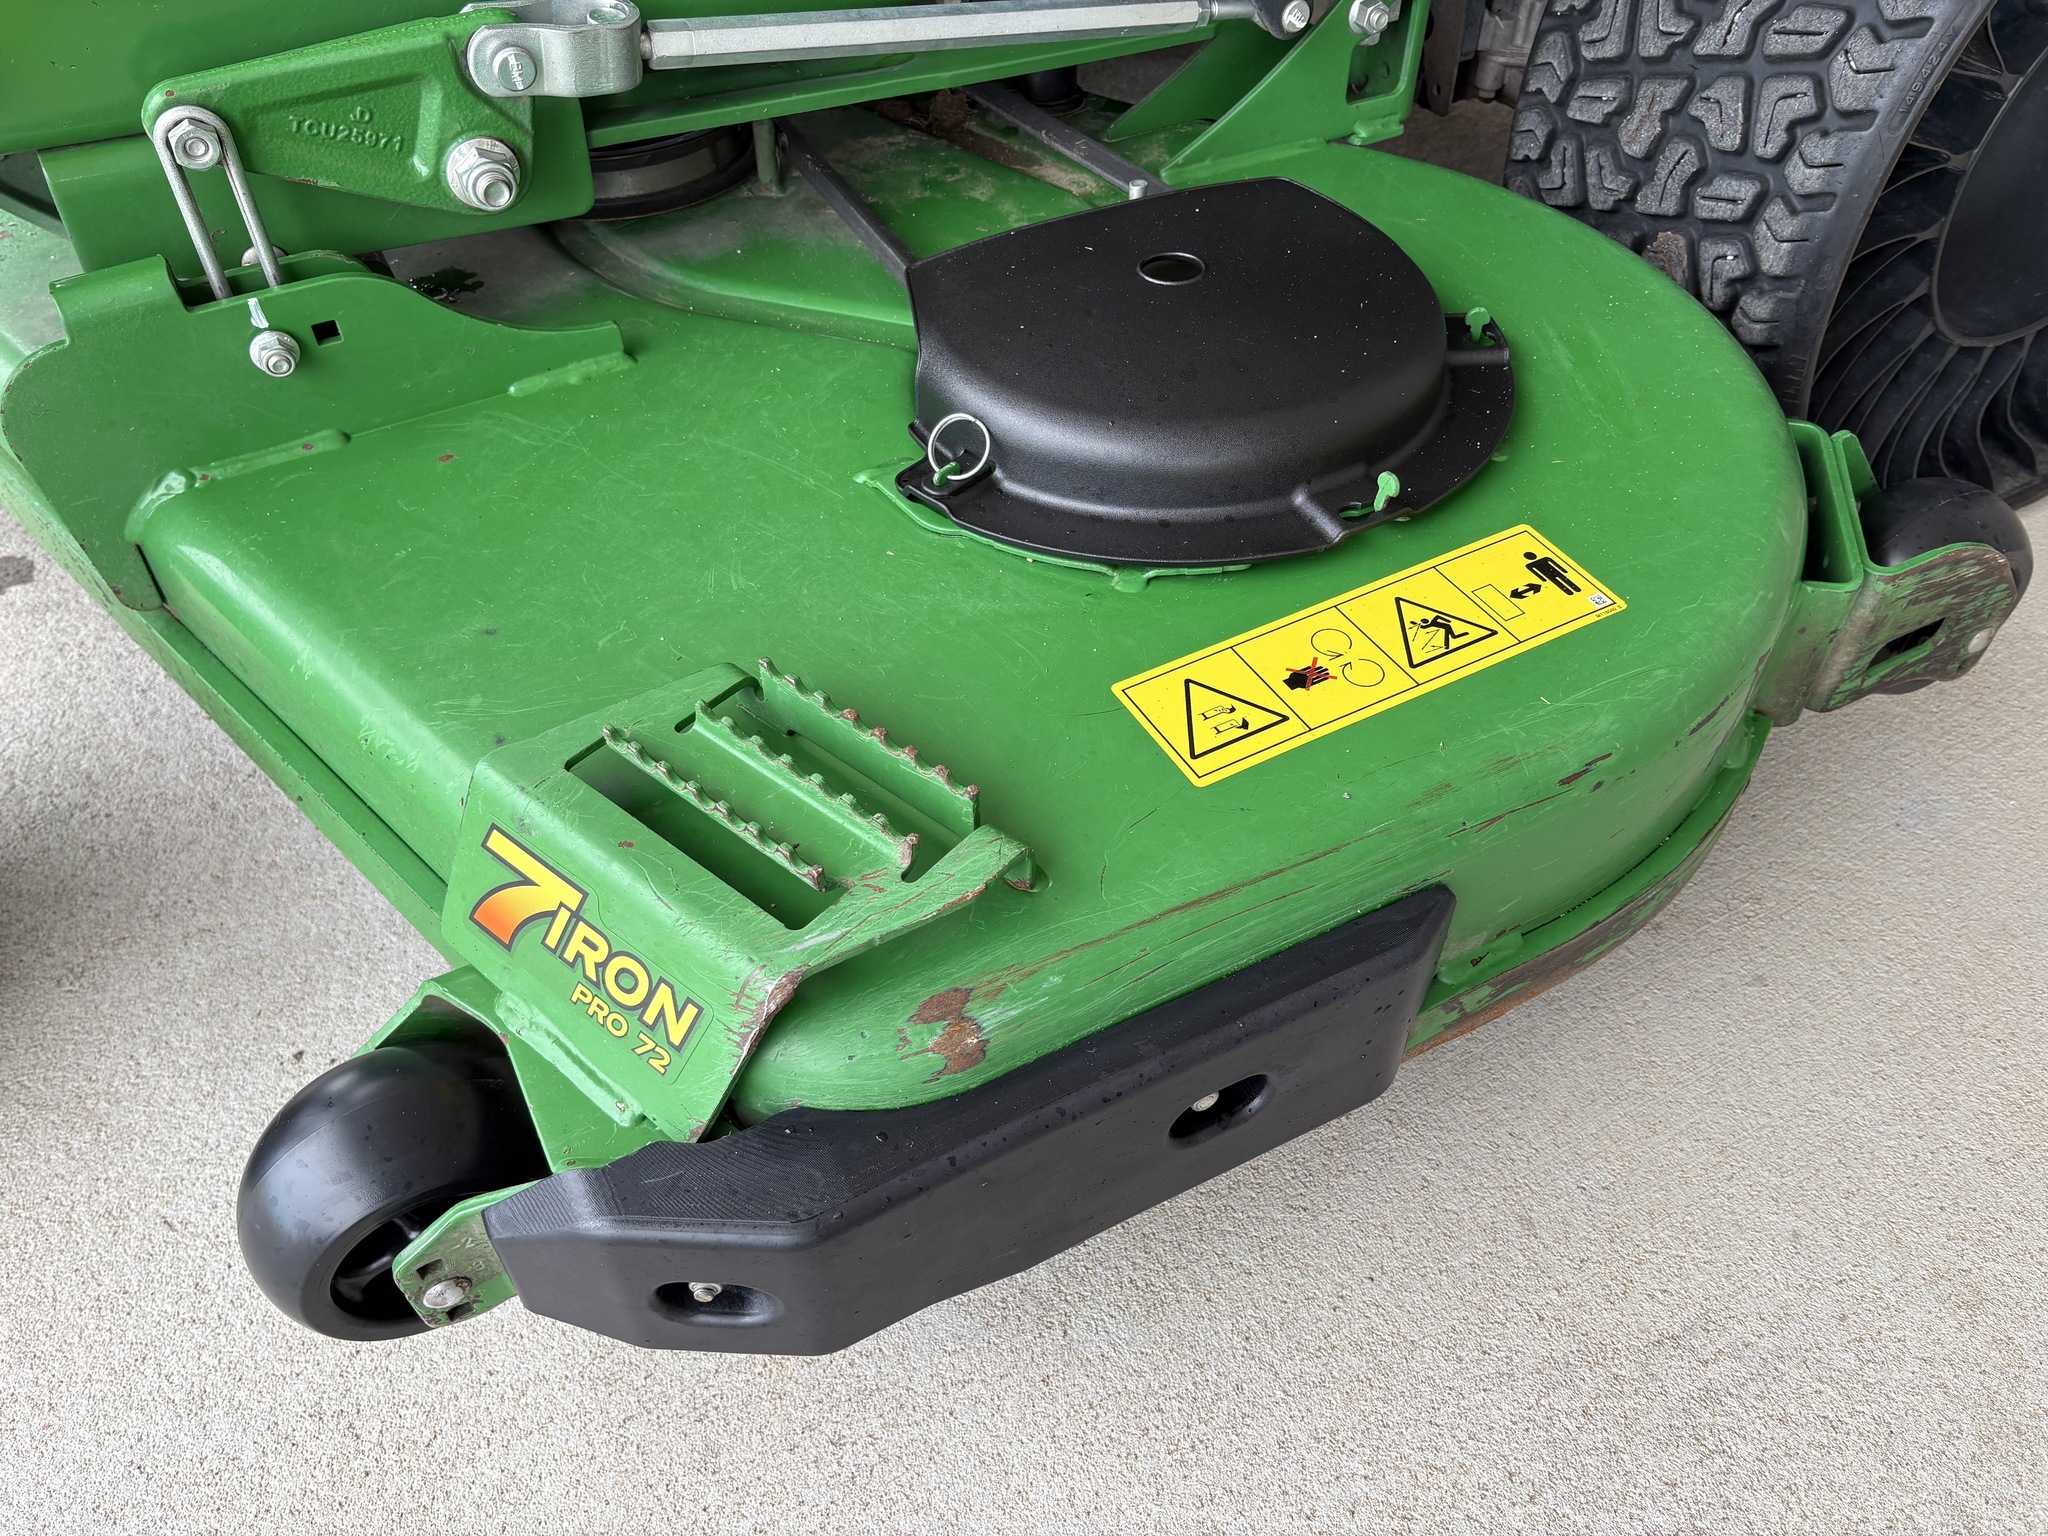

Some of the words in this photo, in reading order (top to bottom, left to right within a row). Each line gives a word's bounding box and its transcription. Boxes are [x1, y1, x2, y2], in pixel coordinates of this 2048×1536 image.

[288, 115, 404, 151] TCU25971
[570, 981, 629, 1038] PRO
[632, 1031, 672, 1076] 72
